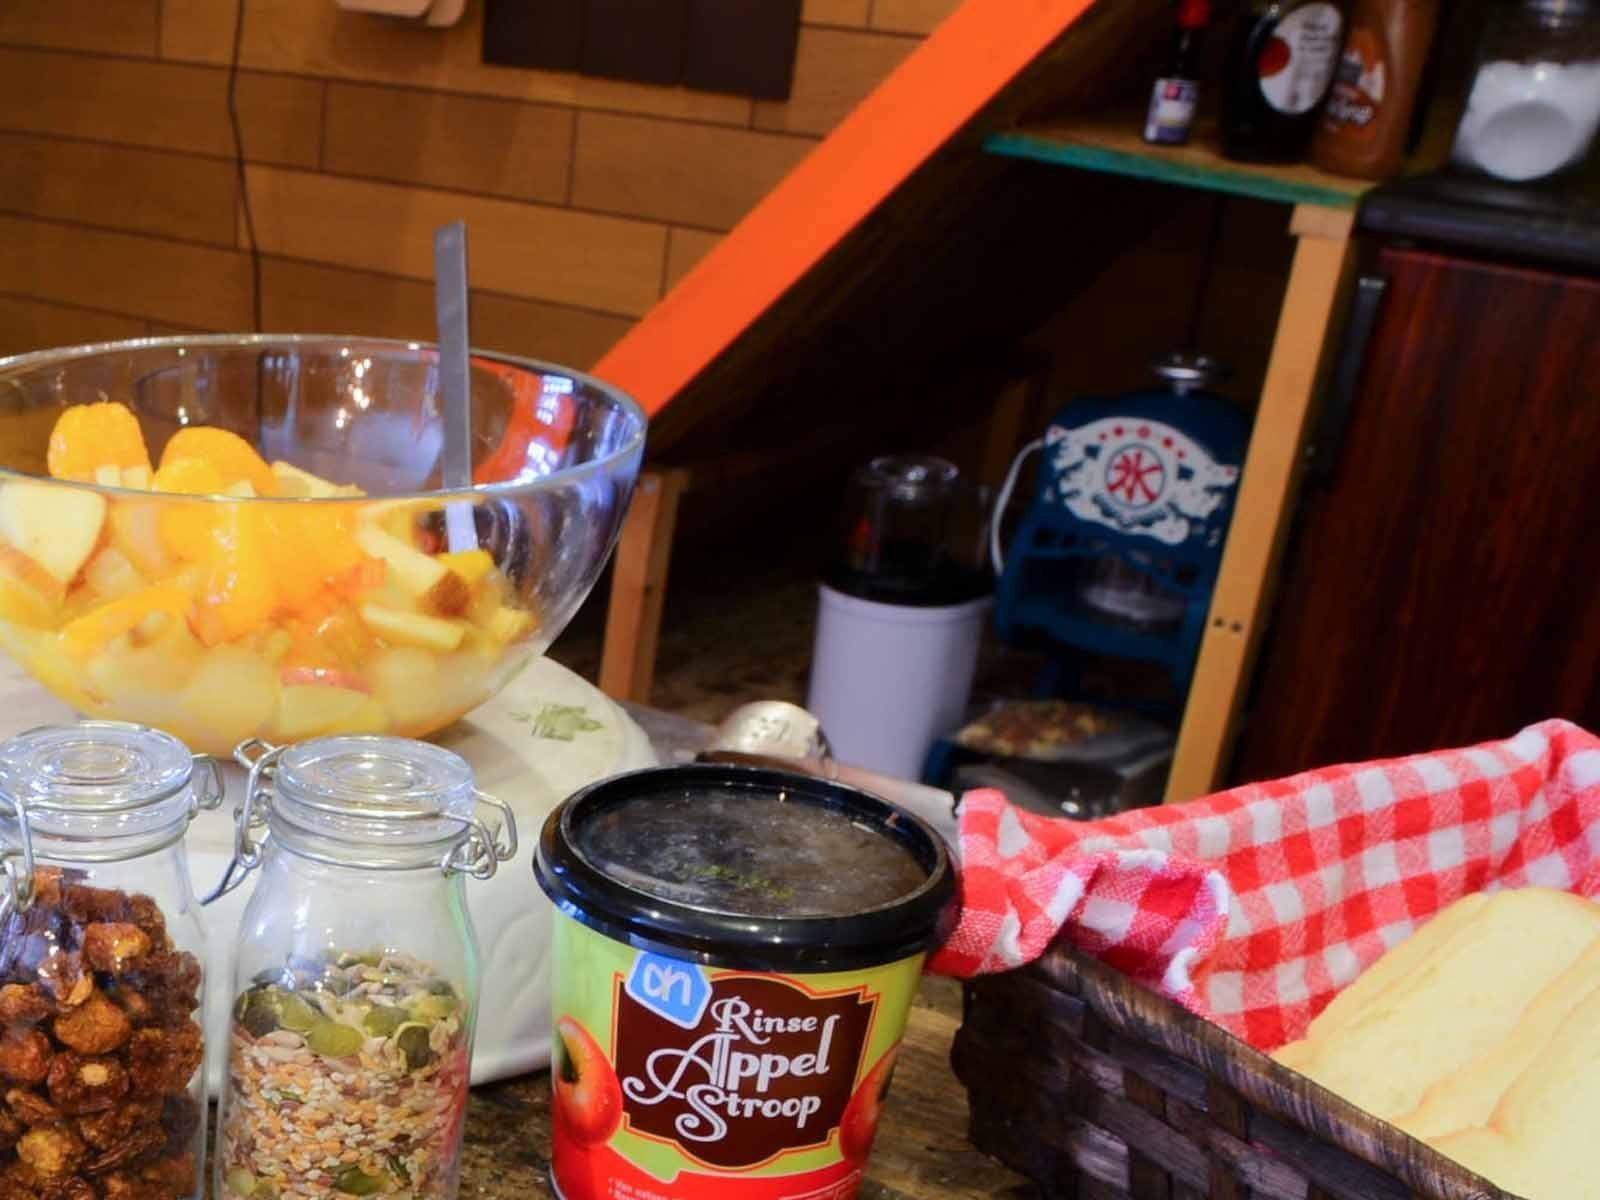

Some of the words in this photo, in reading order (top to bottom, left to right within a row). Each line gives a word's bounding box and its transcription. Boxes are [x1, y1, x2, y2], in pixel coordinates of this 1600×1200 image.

[1106, 450, 1164, 503] 氷
[711, 996, 817, 1044] Rinse
[622, 1015, 840, 1105] Appel
[675, 1084, 822, 1142] Stroop
